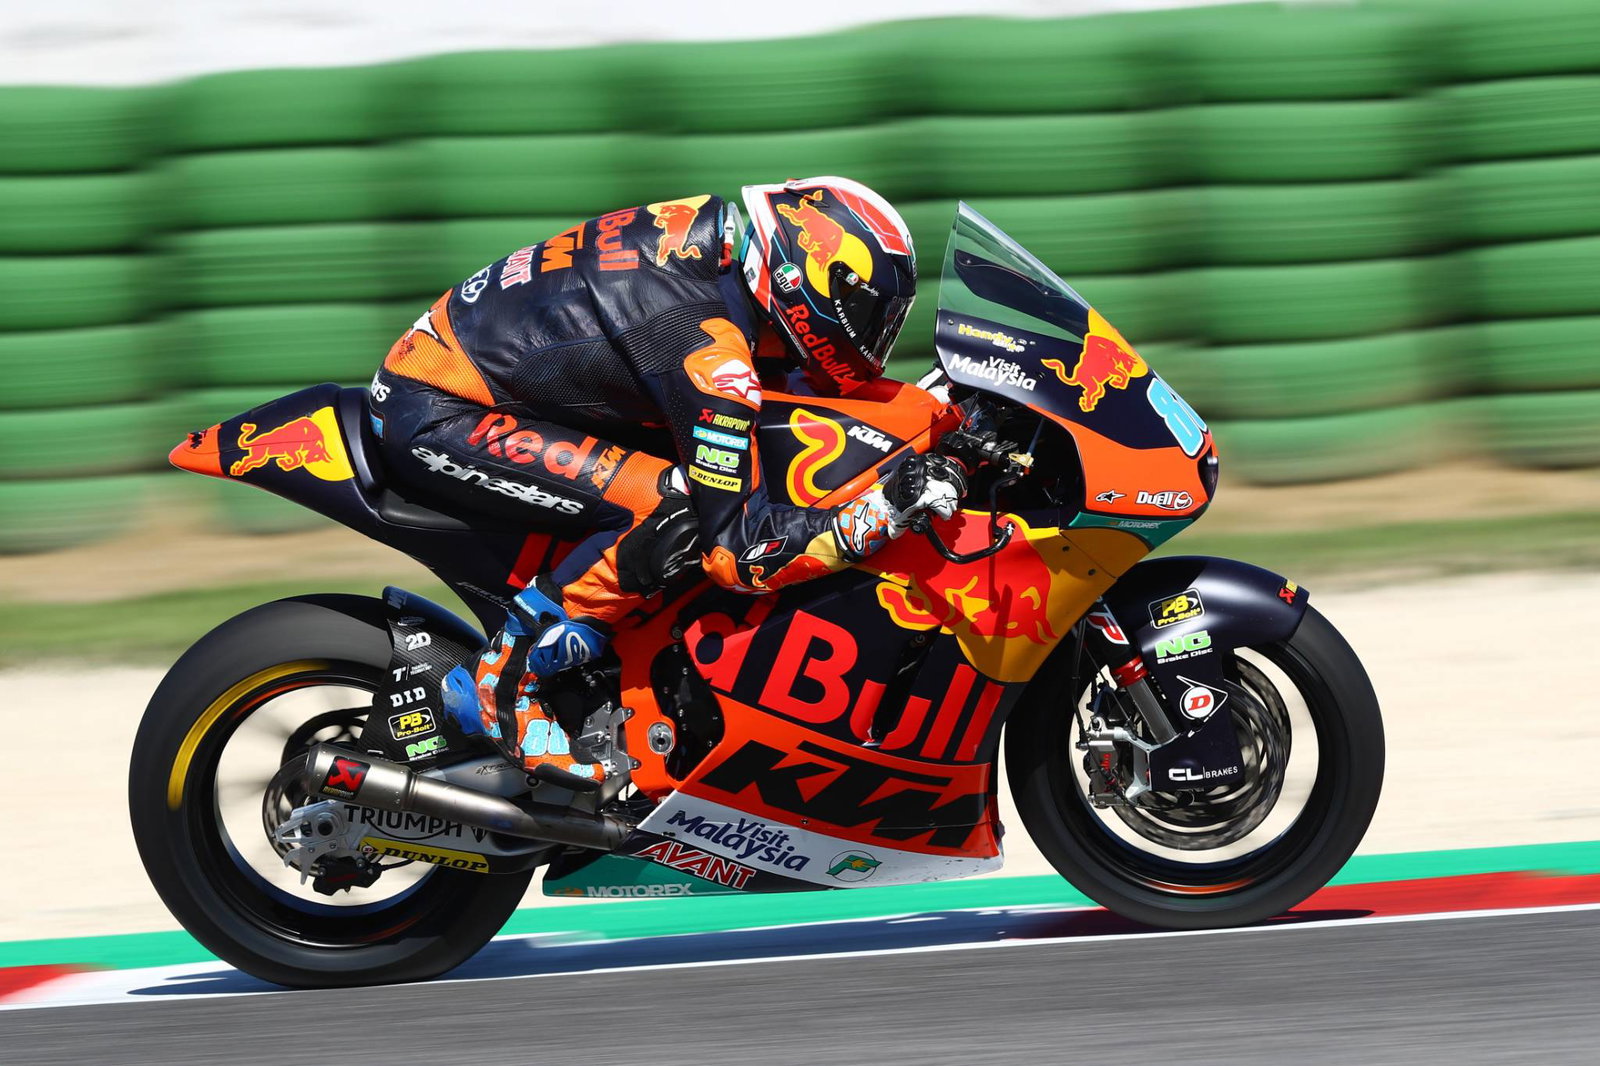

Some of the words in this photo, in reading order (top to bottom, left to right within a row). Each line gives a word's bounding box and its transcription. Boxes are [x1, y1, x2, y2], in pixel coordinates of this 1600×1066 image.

[597, 211, 640, 271] Bull
[834, 299, 857, 338] KARBIUM
[786, 303, 829, 348] Red
[812, 344, 851, 377] Bull
[948, 353, 1037, 391] Malaysia
[989, 356, 1021, 374] Visit
[466, 412, 599, 481] Red
[847, 425, 893, 453] KTM
[696, 445, 740, 468] NG
[697, 472, 738, 487] DUNLOP
[405, 631, 432, 651] 2D
[1154, 630, 1212, 659] NG
[1157, 653, 1189, 665] Brake
[1190, 647, 1213, 657] Disc
[757, 609, 1005, 762] Bull
[399, 712, 423, 730] PB
[1168, 767, 1204, 782] CL
[1205, 765, 1239, 779] BRAKES
[698, 739, 989, 850] KTM
[343, 804, 463, 838] TRIUMPH
[736, 817, 790, 847] Visit
[666, 809, 811, 872] Malaysia
[381, 846, 488, 871] DUNLOP
[632, 840, 757, 890] AVANT
[586, 882, 696, 898] MOTOREX
